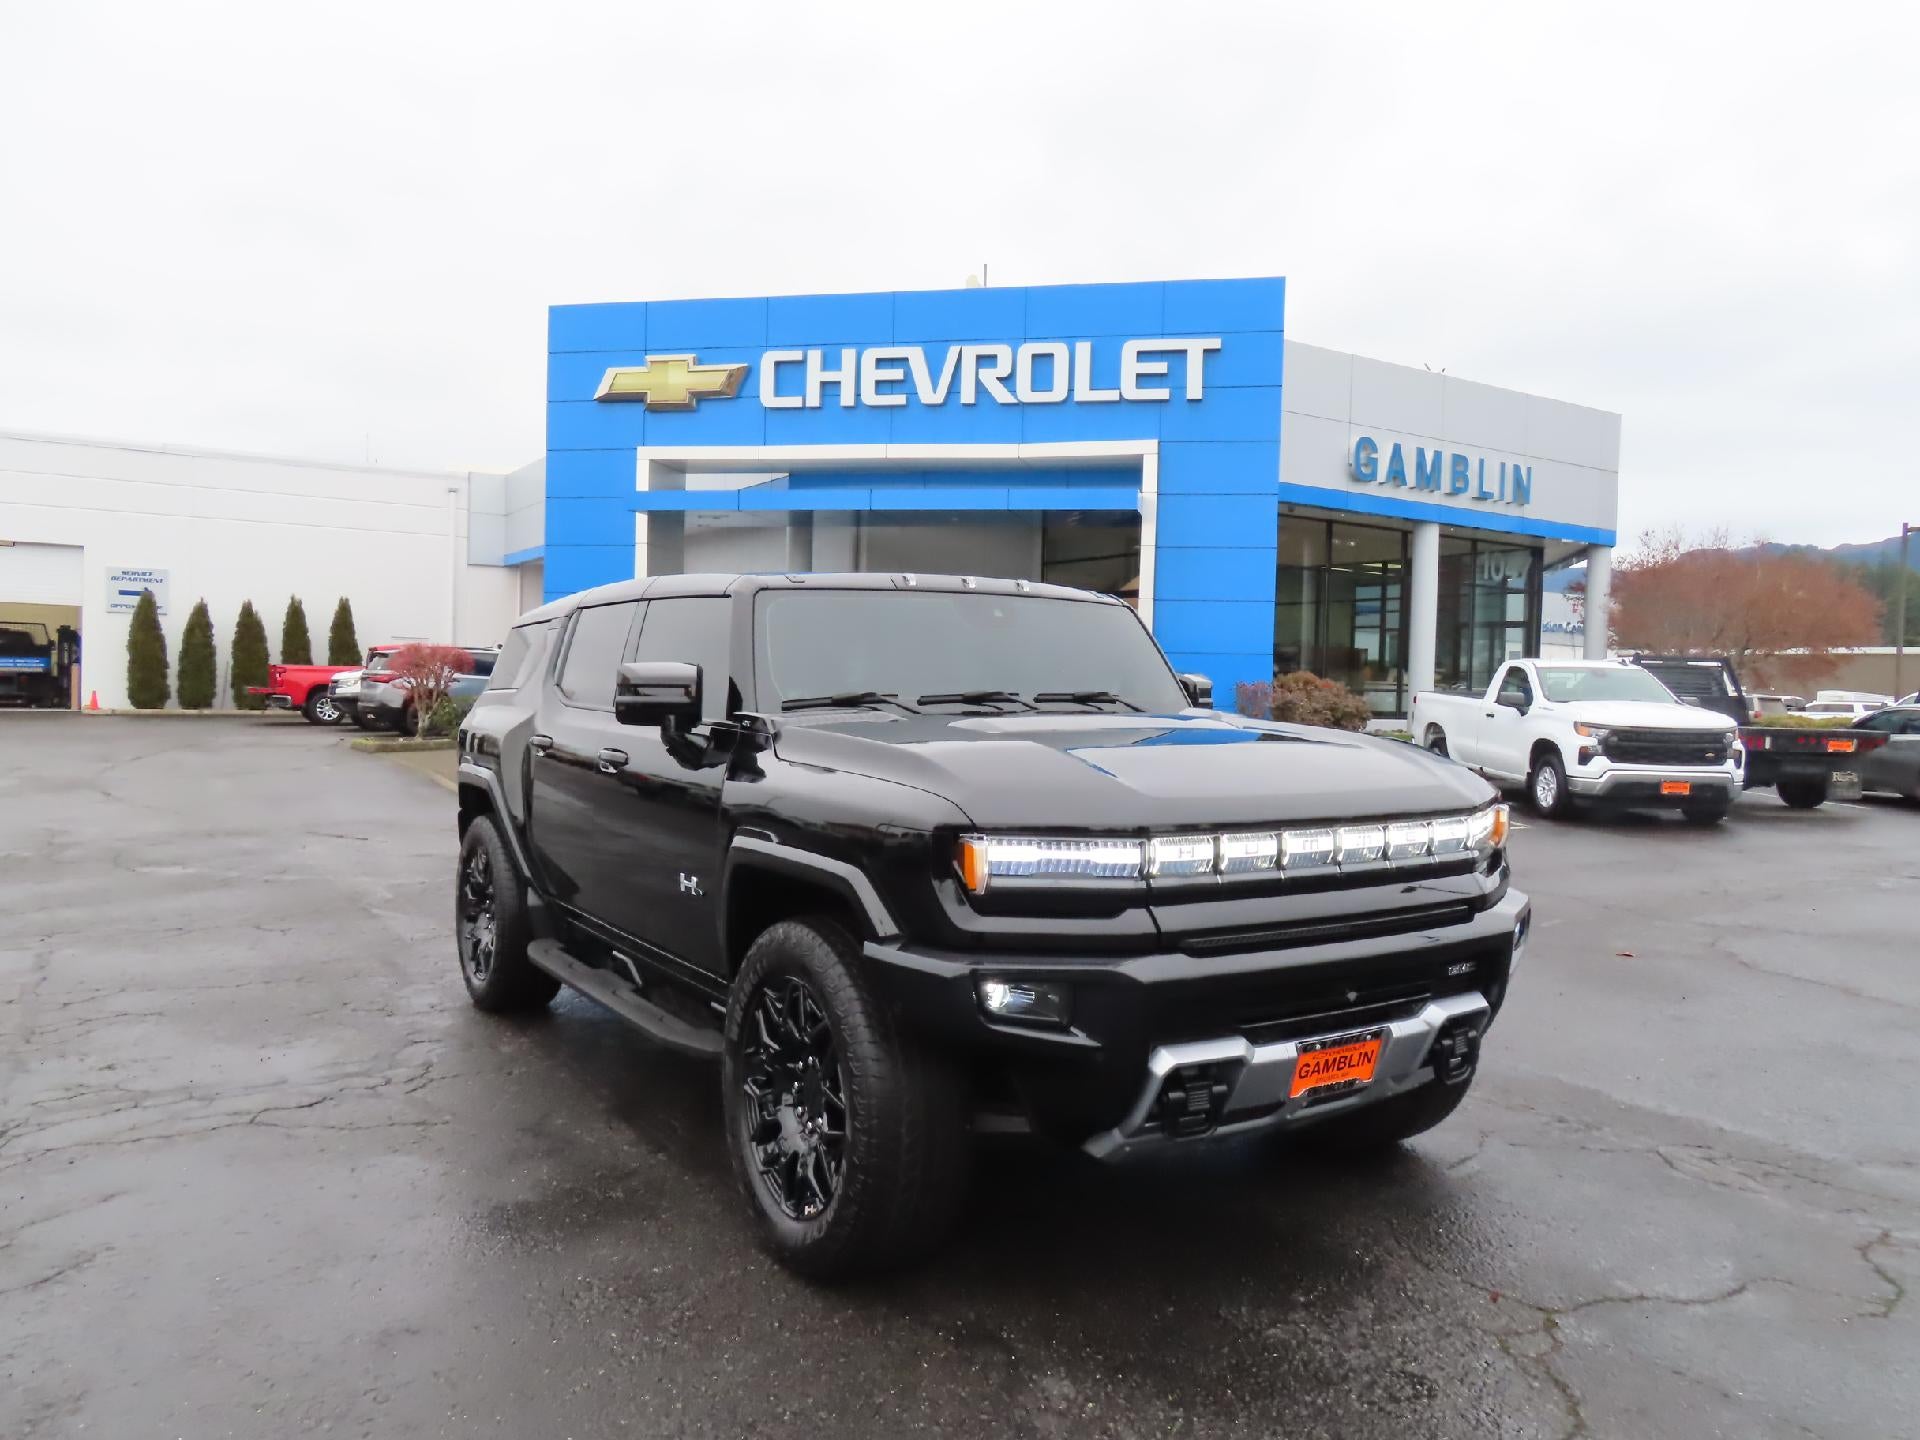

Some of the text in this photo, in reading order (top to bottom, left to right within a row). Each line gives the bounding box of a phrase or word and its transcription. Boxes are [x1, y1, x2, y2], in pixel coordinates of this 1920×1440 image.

[759, 337, 1222, 408] CHEVROLET
[1354, 436, 1532, 506] GAMBLIN
[1298, 1049, 1375, 1080] GAMBLIN
